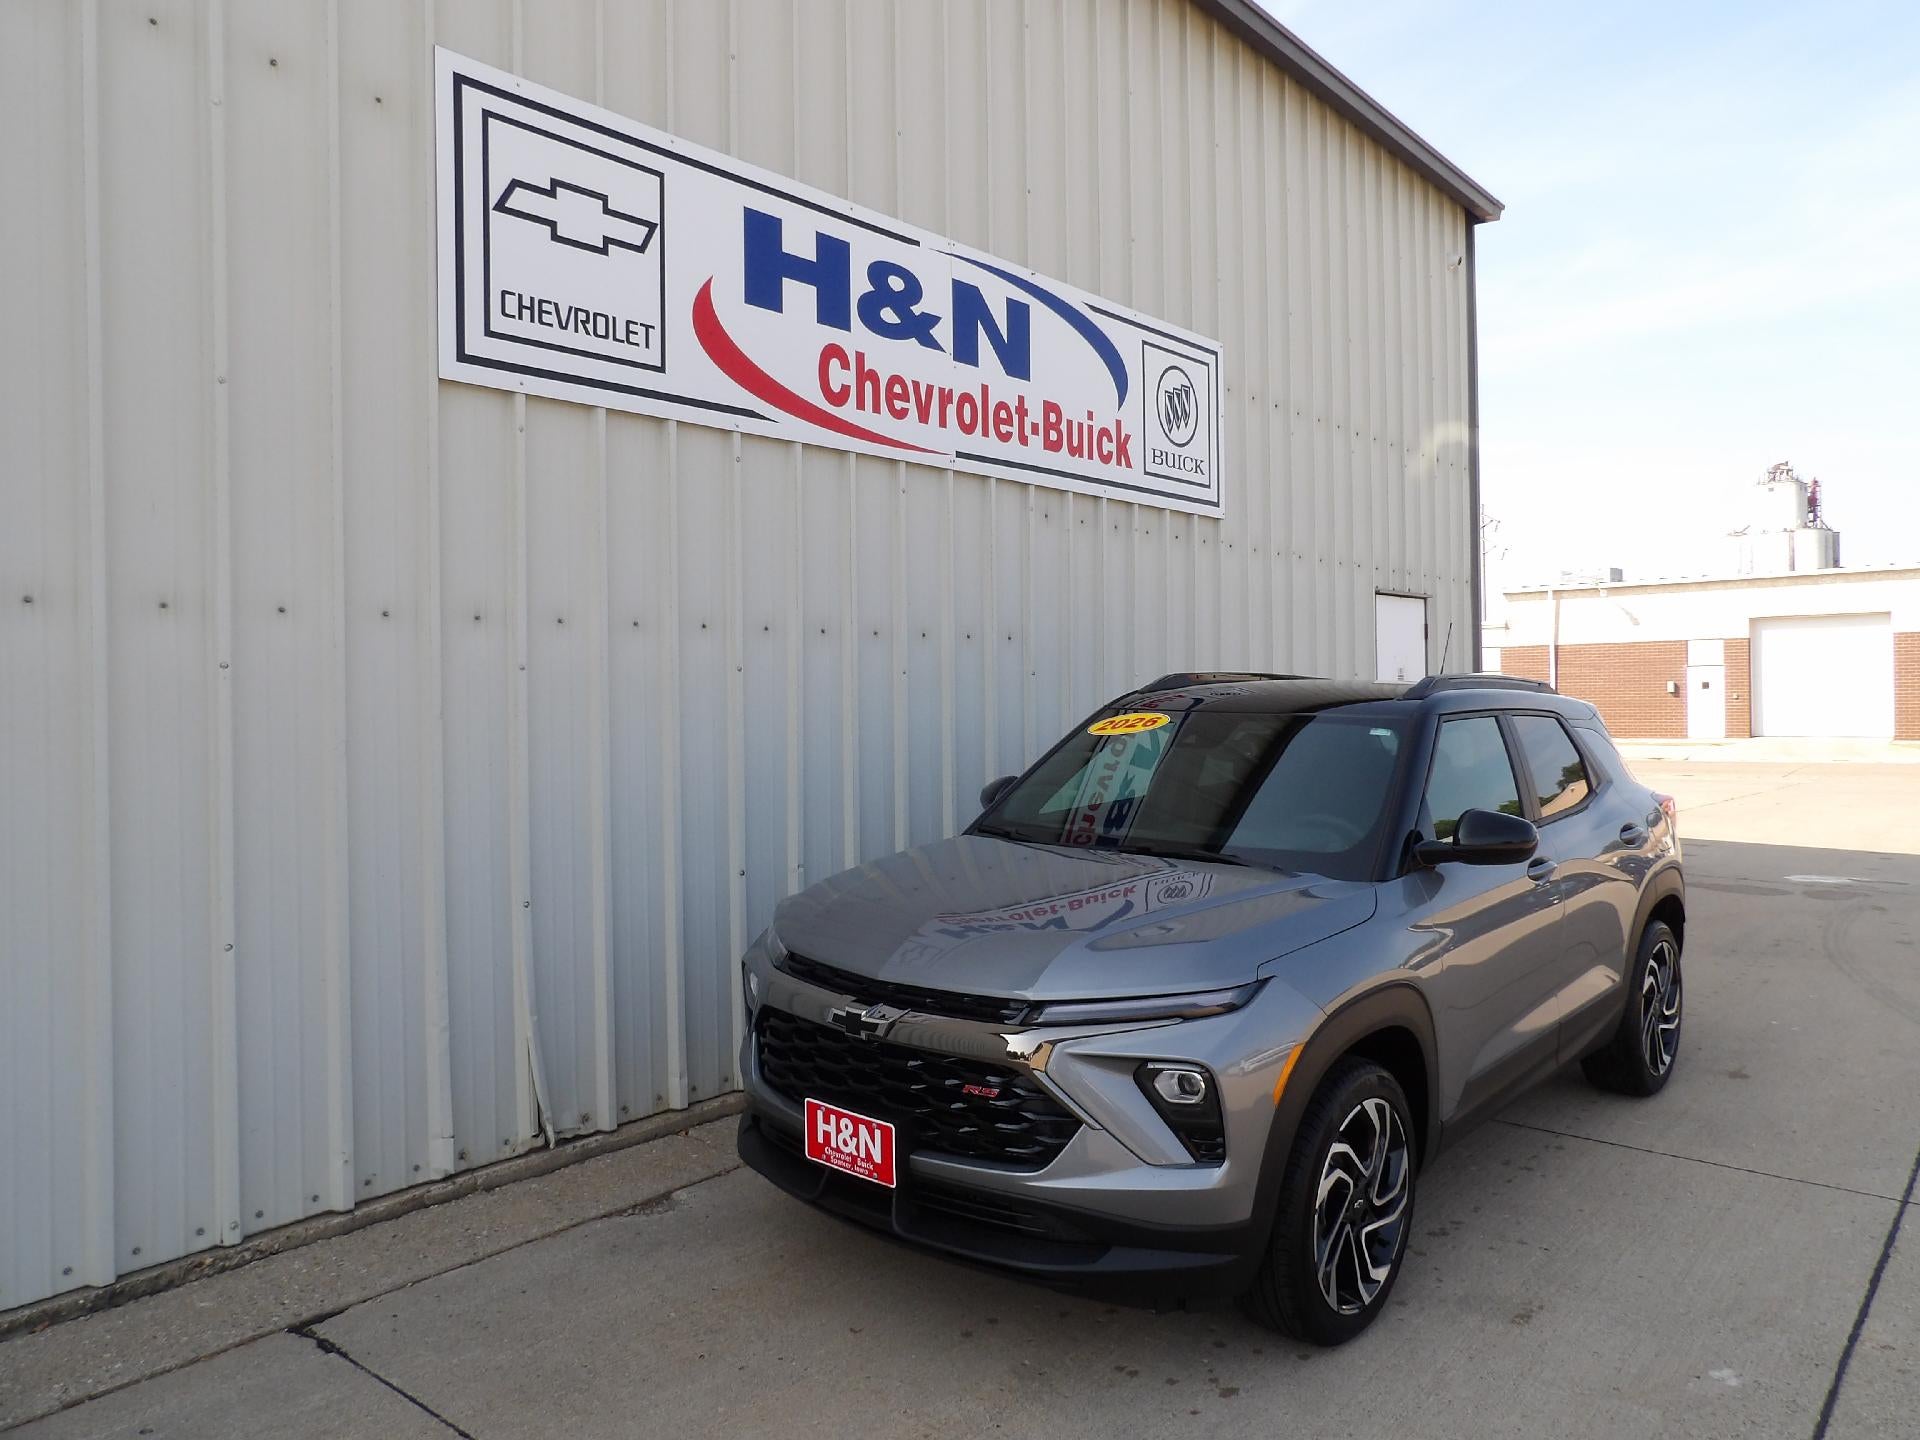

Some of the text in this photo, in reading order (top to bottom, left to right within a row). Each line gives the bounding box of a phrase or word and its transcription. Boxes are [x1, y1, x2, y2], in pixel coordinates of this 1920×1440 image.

[743, 206, 1030, 382] H&N
[500, 289, 656, 349] CHEVROLET
[818, 343, 1133, 469] Chevrolet-Buick
[1151, 448, 1205, 475] BUICK
[1093, 717, 1163, 732] 2026
[962, 1084, 1000, 1098] RS
[817, 1109, 882, 1164] H&N
[824, 1146, 874, 1171] Chevrolet Buick
